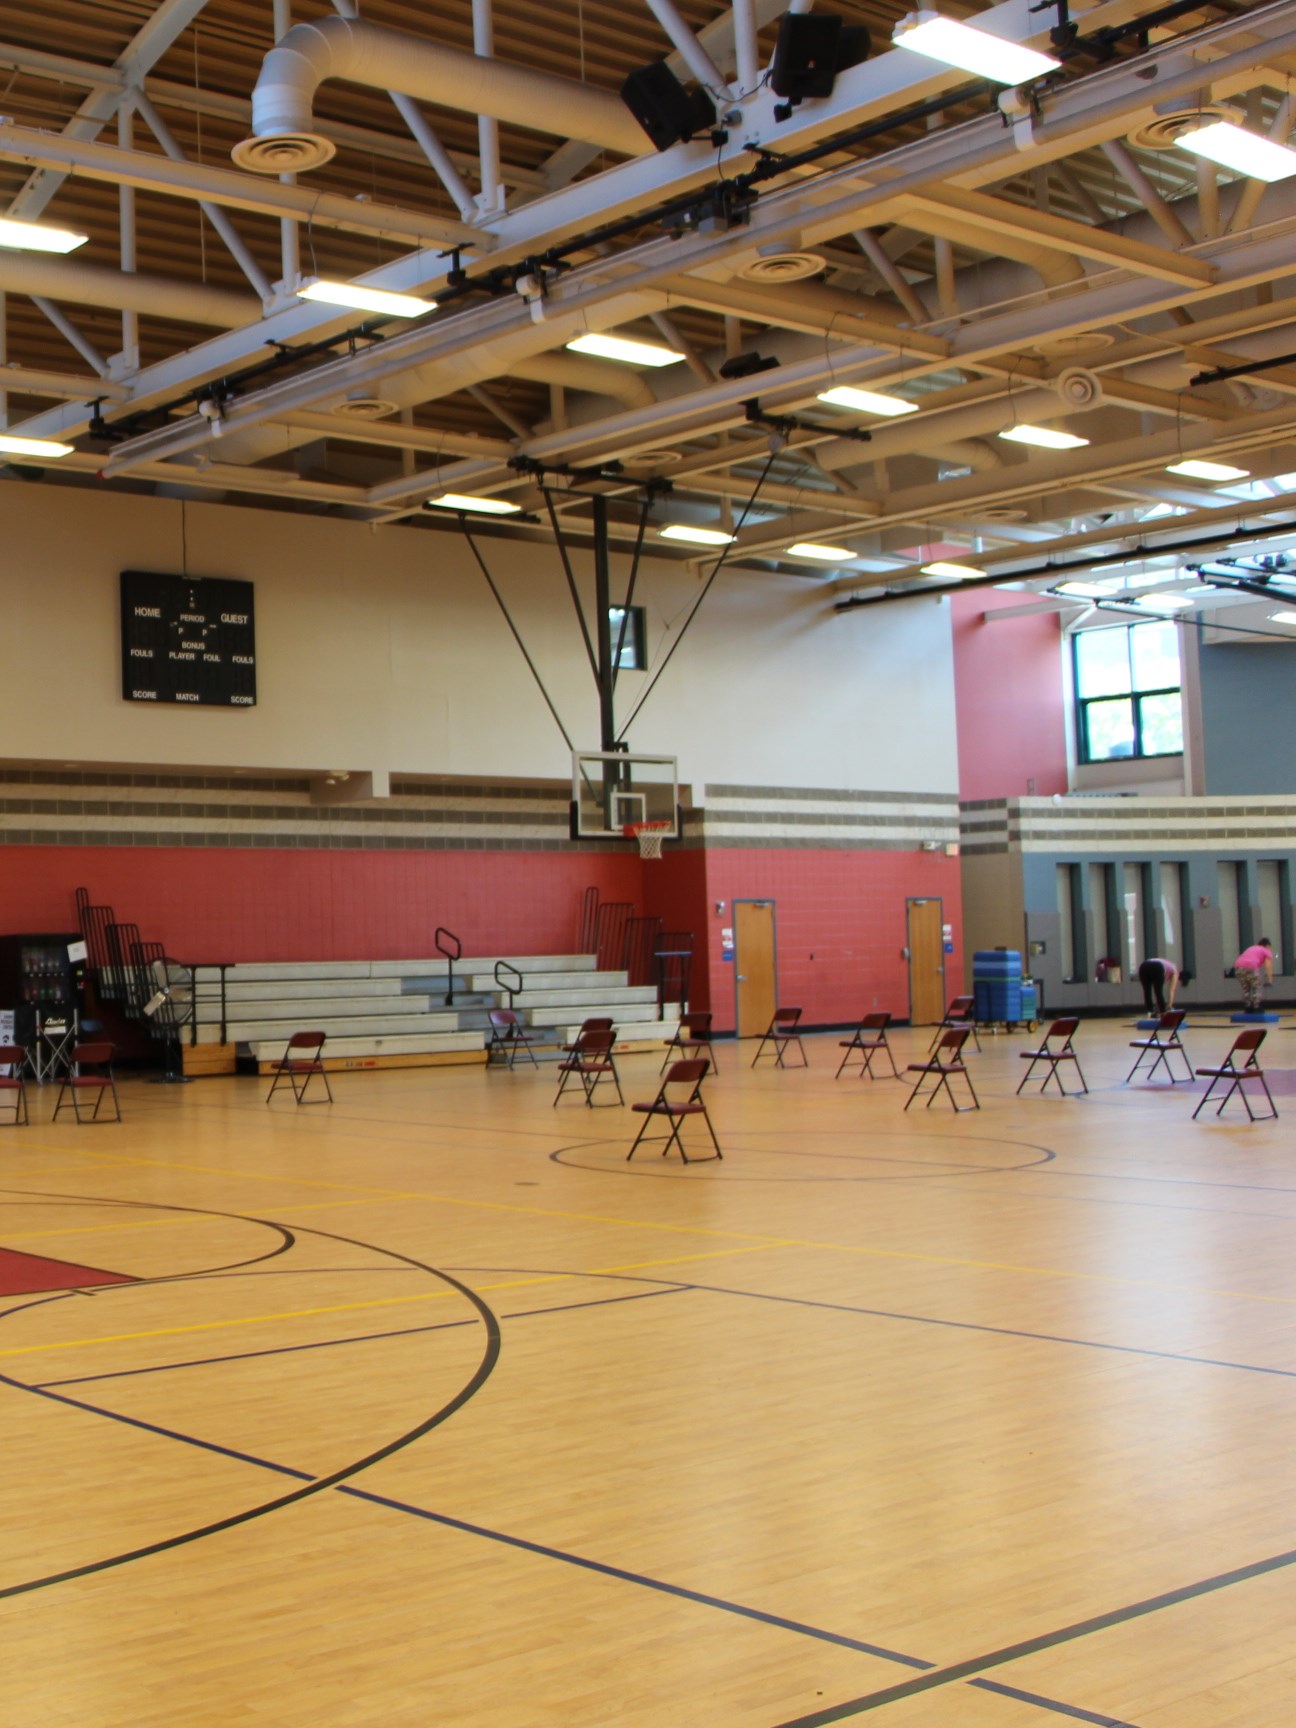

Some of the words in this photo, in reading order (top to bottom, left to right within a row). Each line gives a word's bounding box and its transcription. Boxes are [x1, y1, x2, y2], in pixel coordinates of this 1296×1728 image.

[134, 607, 161, 618] HOME
[180, 613, 205, 623] PERIOD
[220, 613, 248, 625] GUEST
[181, 641, 205, 650] BONUS
[130, 649, 153, 658] FOULS
[169, 651, 195, 661] PLAYER
[203, 653, 221, 663] FOUL
[232, 655, 254, 665] FOULS
[132, 690, 157, 699] SCORE
[175, 692, 199, 702] MATCH
[230, 696, 254, 705] SCORE
